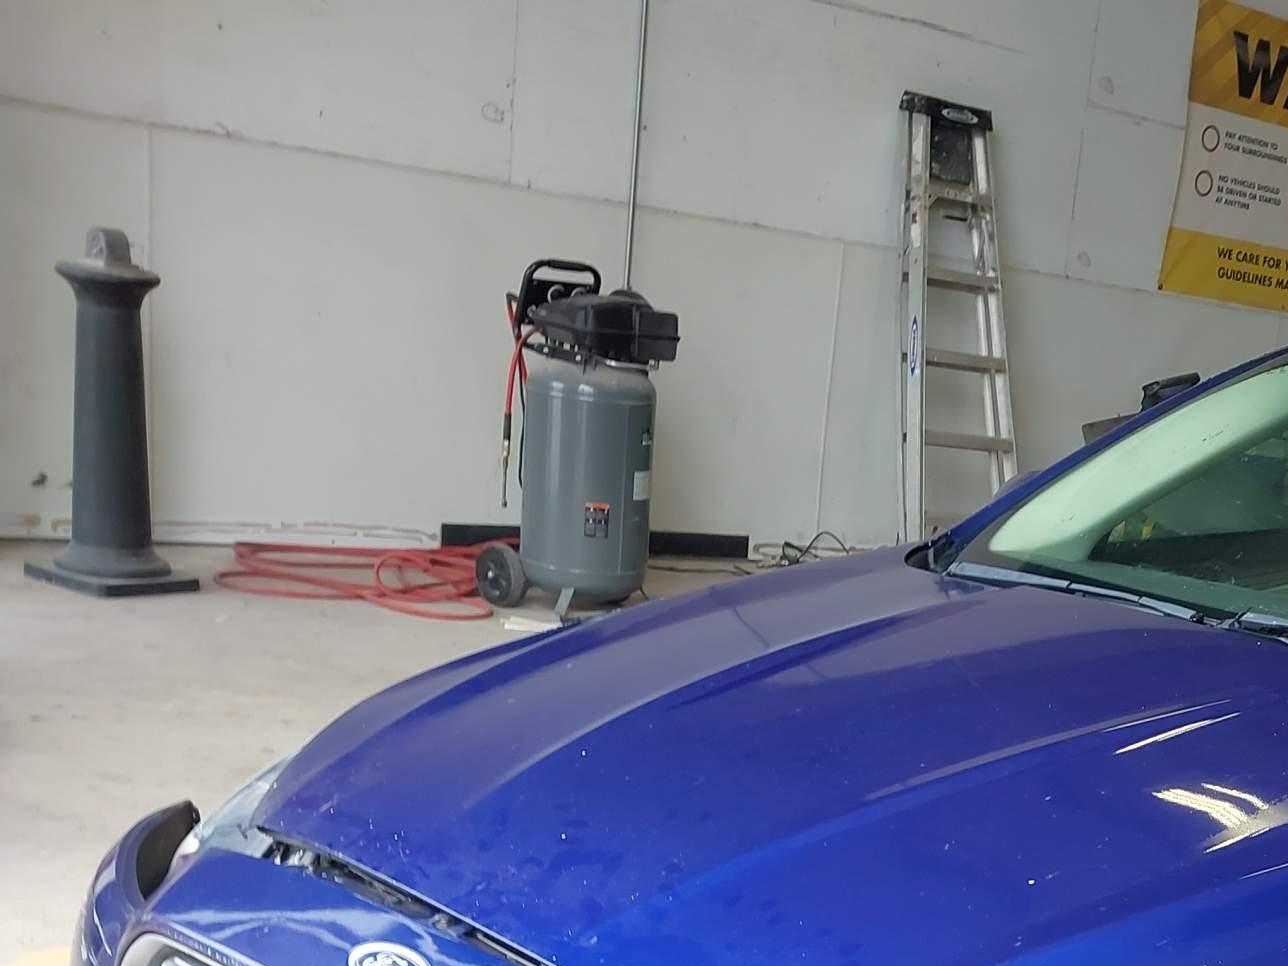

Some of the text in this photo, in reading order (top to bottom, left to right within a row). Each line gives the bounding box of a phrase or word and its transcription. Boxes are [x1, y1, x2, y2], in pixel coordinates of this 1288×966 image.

[1270, 142, 1279, 151] TO
[1218, 175, 1280, 195] NO VEHICLES SHOULD
[1225, 187, 1247, 198] DRIVEN
[1248, 192, 1257, 200] OR
[1259, 195, 1281, 206] STARTED
[1217, 246, 1233, 260] WE
[1235, 250, 1260, 266] CARE
[1262, 256, 1281, 270] FOR
[1217, 266, 1272, 287] GUIDELINES
